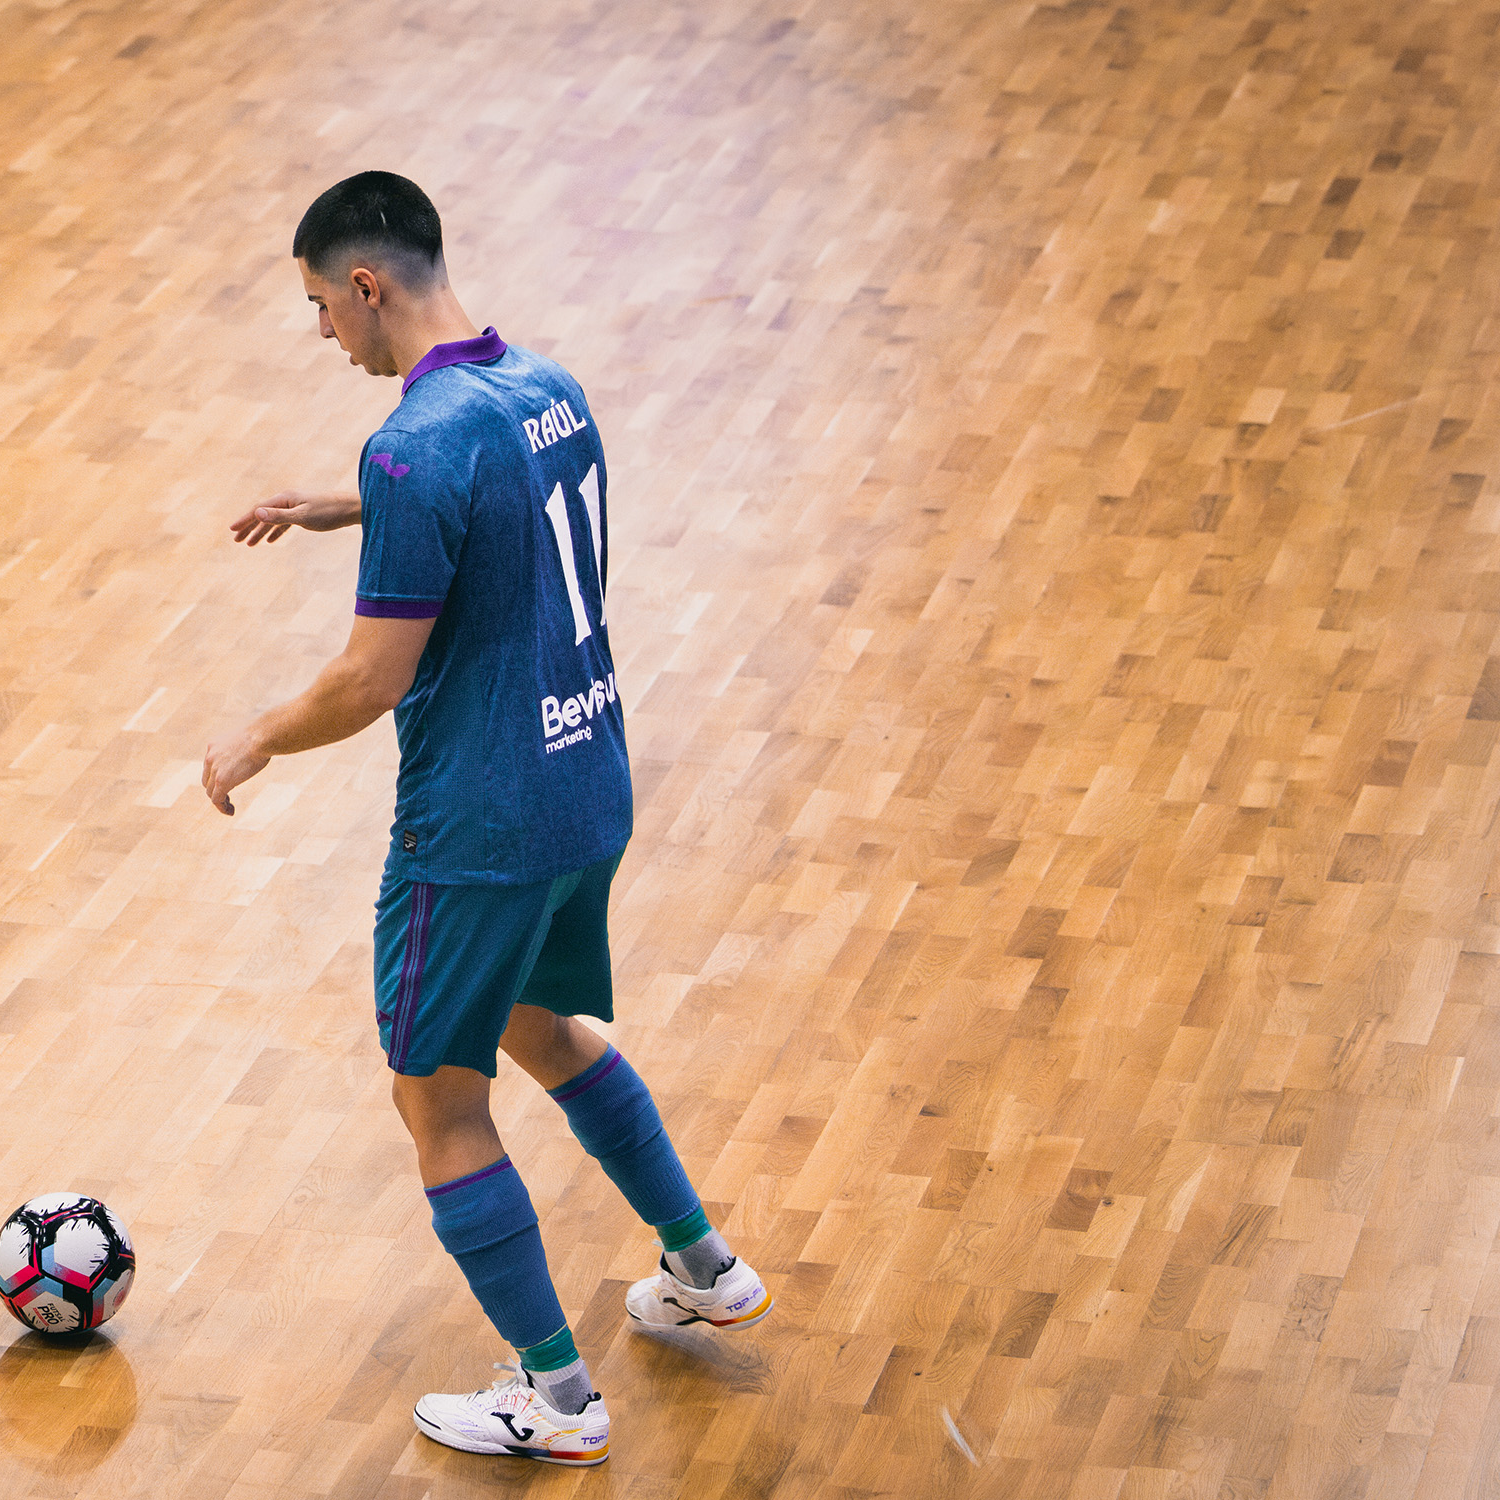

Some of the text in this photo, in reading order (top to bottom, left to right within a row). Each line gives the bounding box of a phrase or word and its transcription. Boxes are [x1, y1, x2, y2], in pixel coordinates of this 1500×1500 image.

[521, 398, 588, 454] RAÚL
[544, 462, 607, 647] 11
[545, 725, 593, 754] marketing
[37, 1305, 59, 1325] PRO
[47, 1302, 65, 1322] FUTSAL
